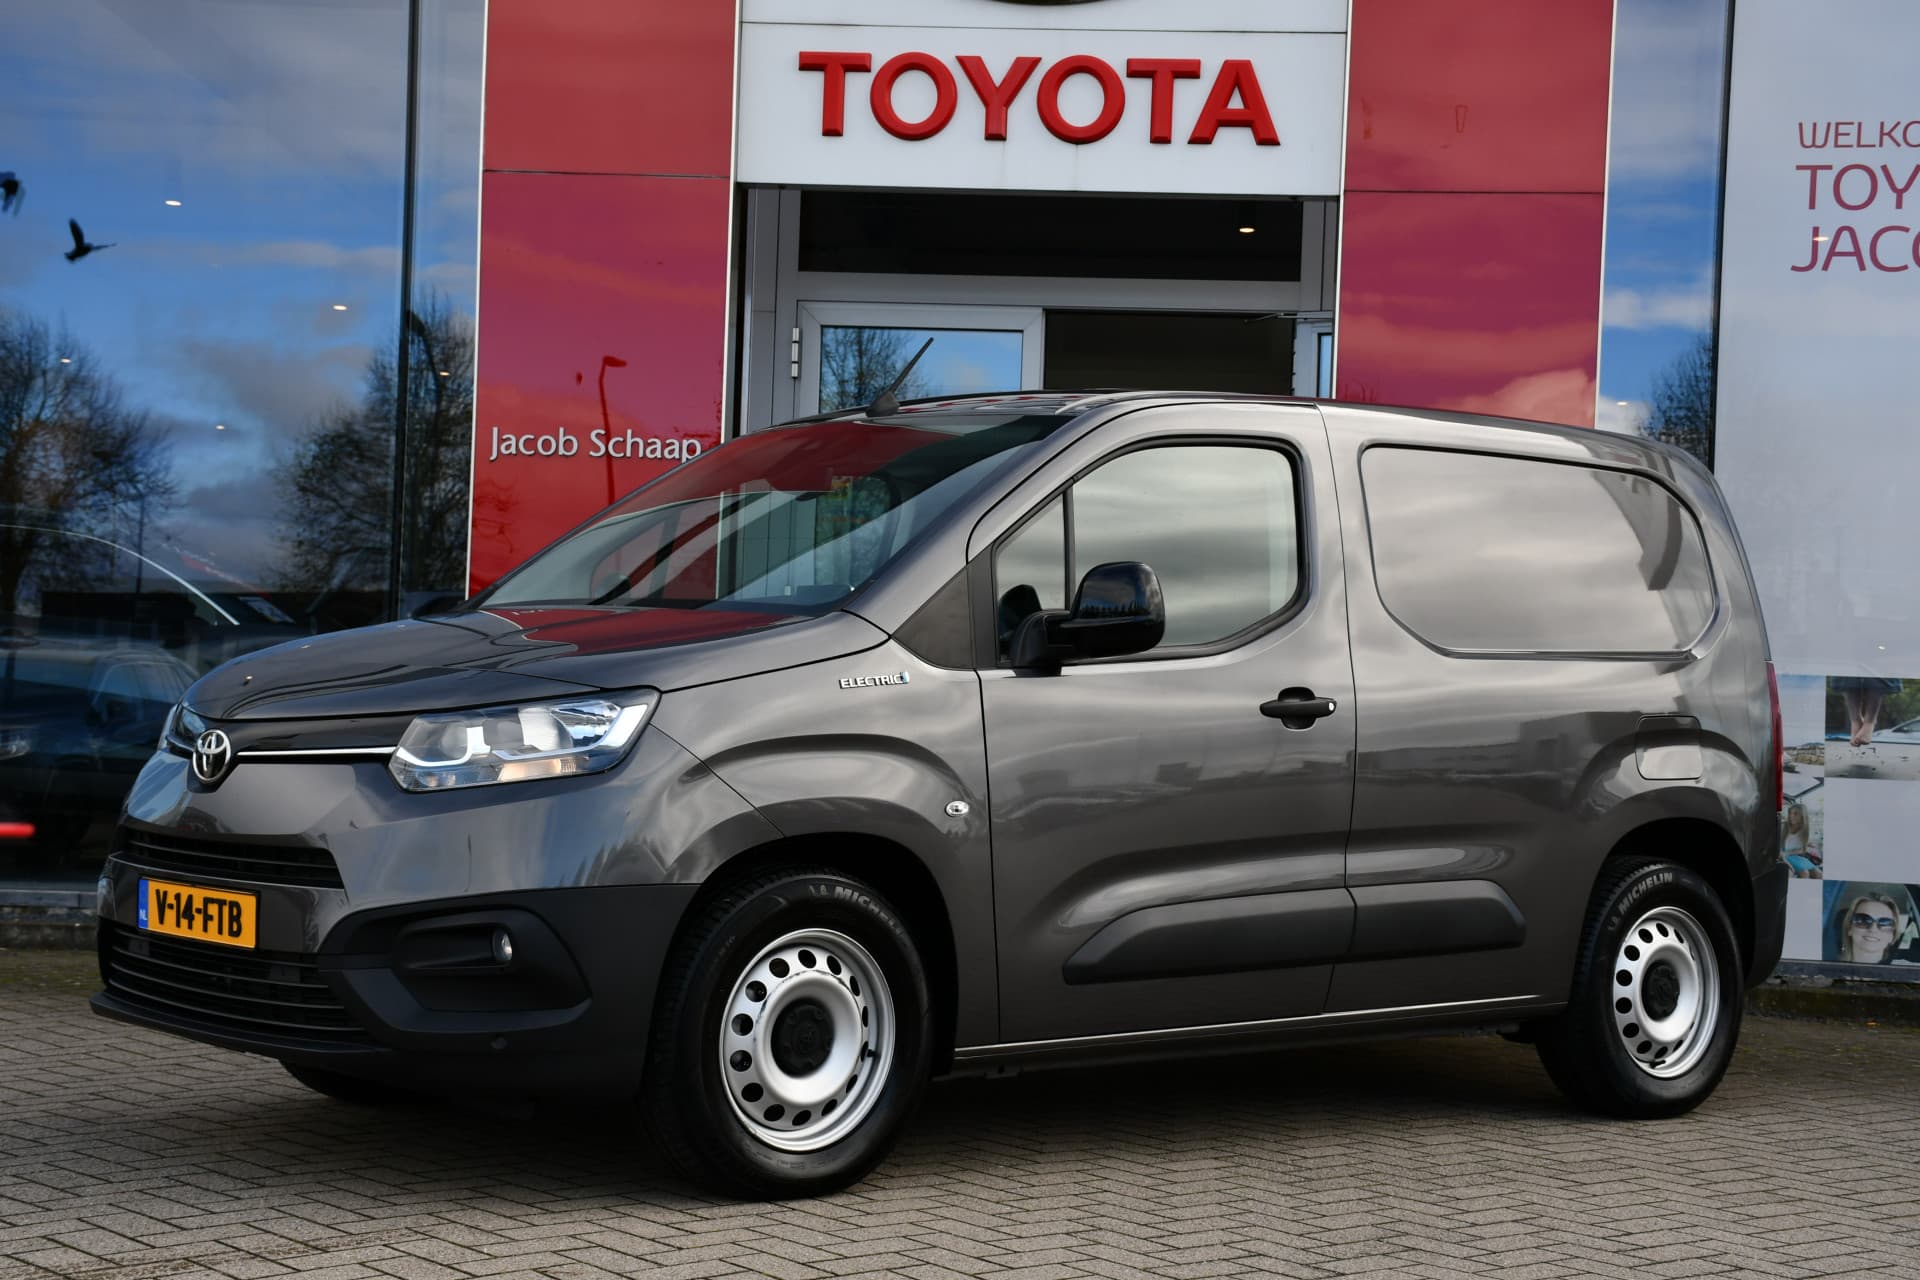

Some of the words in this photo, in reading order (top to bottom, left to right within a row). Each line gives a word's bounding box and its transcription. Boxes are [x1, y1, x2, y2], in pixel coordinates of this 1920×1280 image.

[798, 50, 1281, 146] TOYOTA
[1795, 163, 1920, 211] TOY
[1790, 225, 1920, 272] JAC
[489, 426, 579, 462] Jacob
[588, 428, 702, 464] Schaap
[838, 674, 903, 690] ELECTRIC
[154, 888, 243, 939] V-14-FTB
[1617, 871, 1674, 916] MICHELIN
